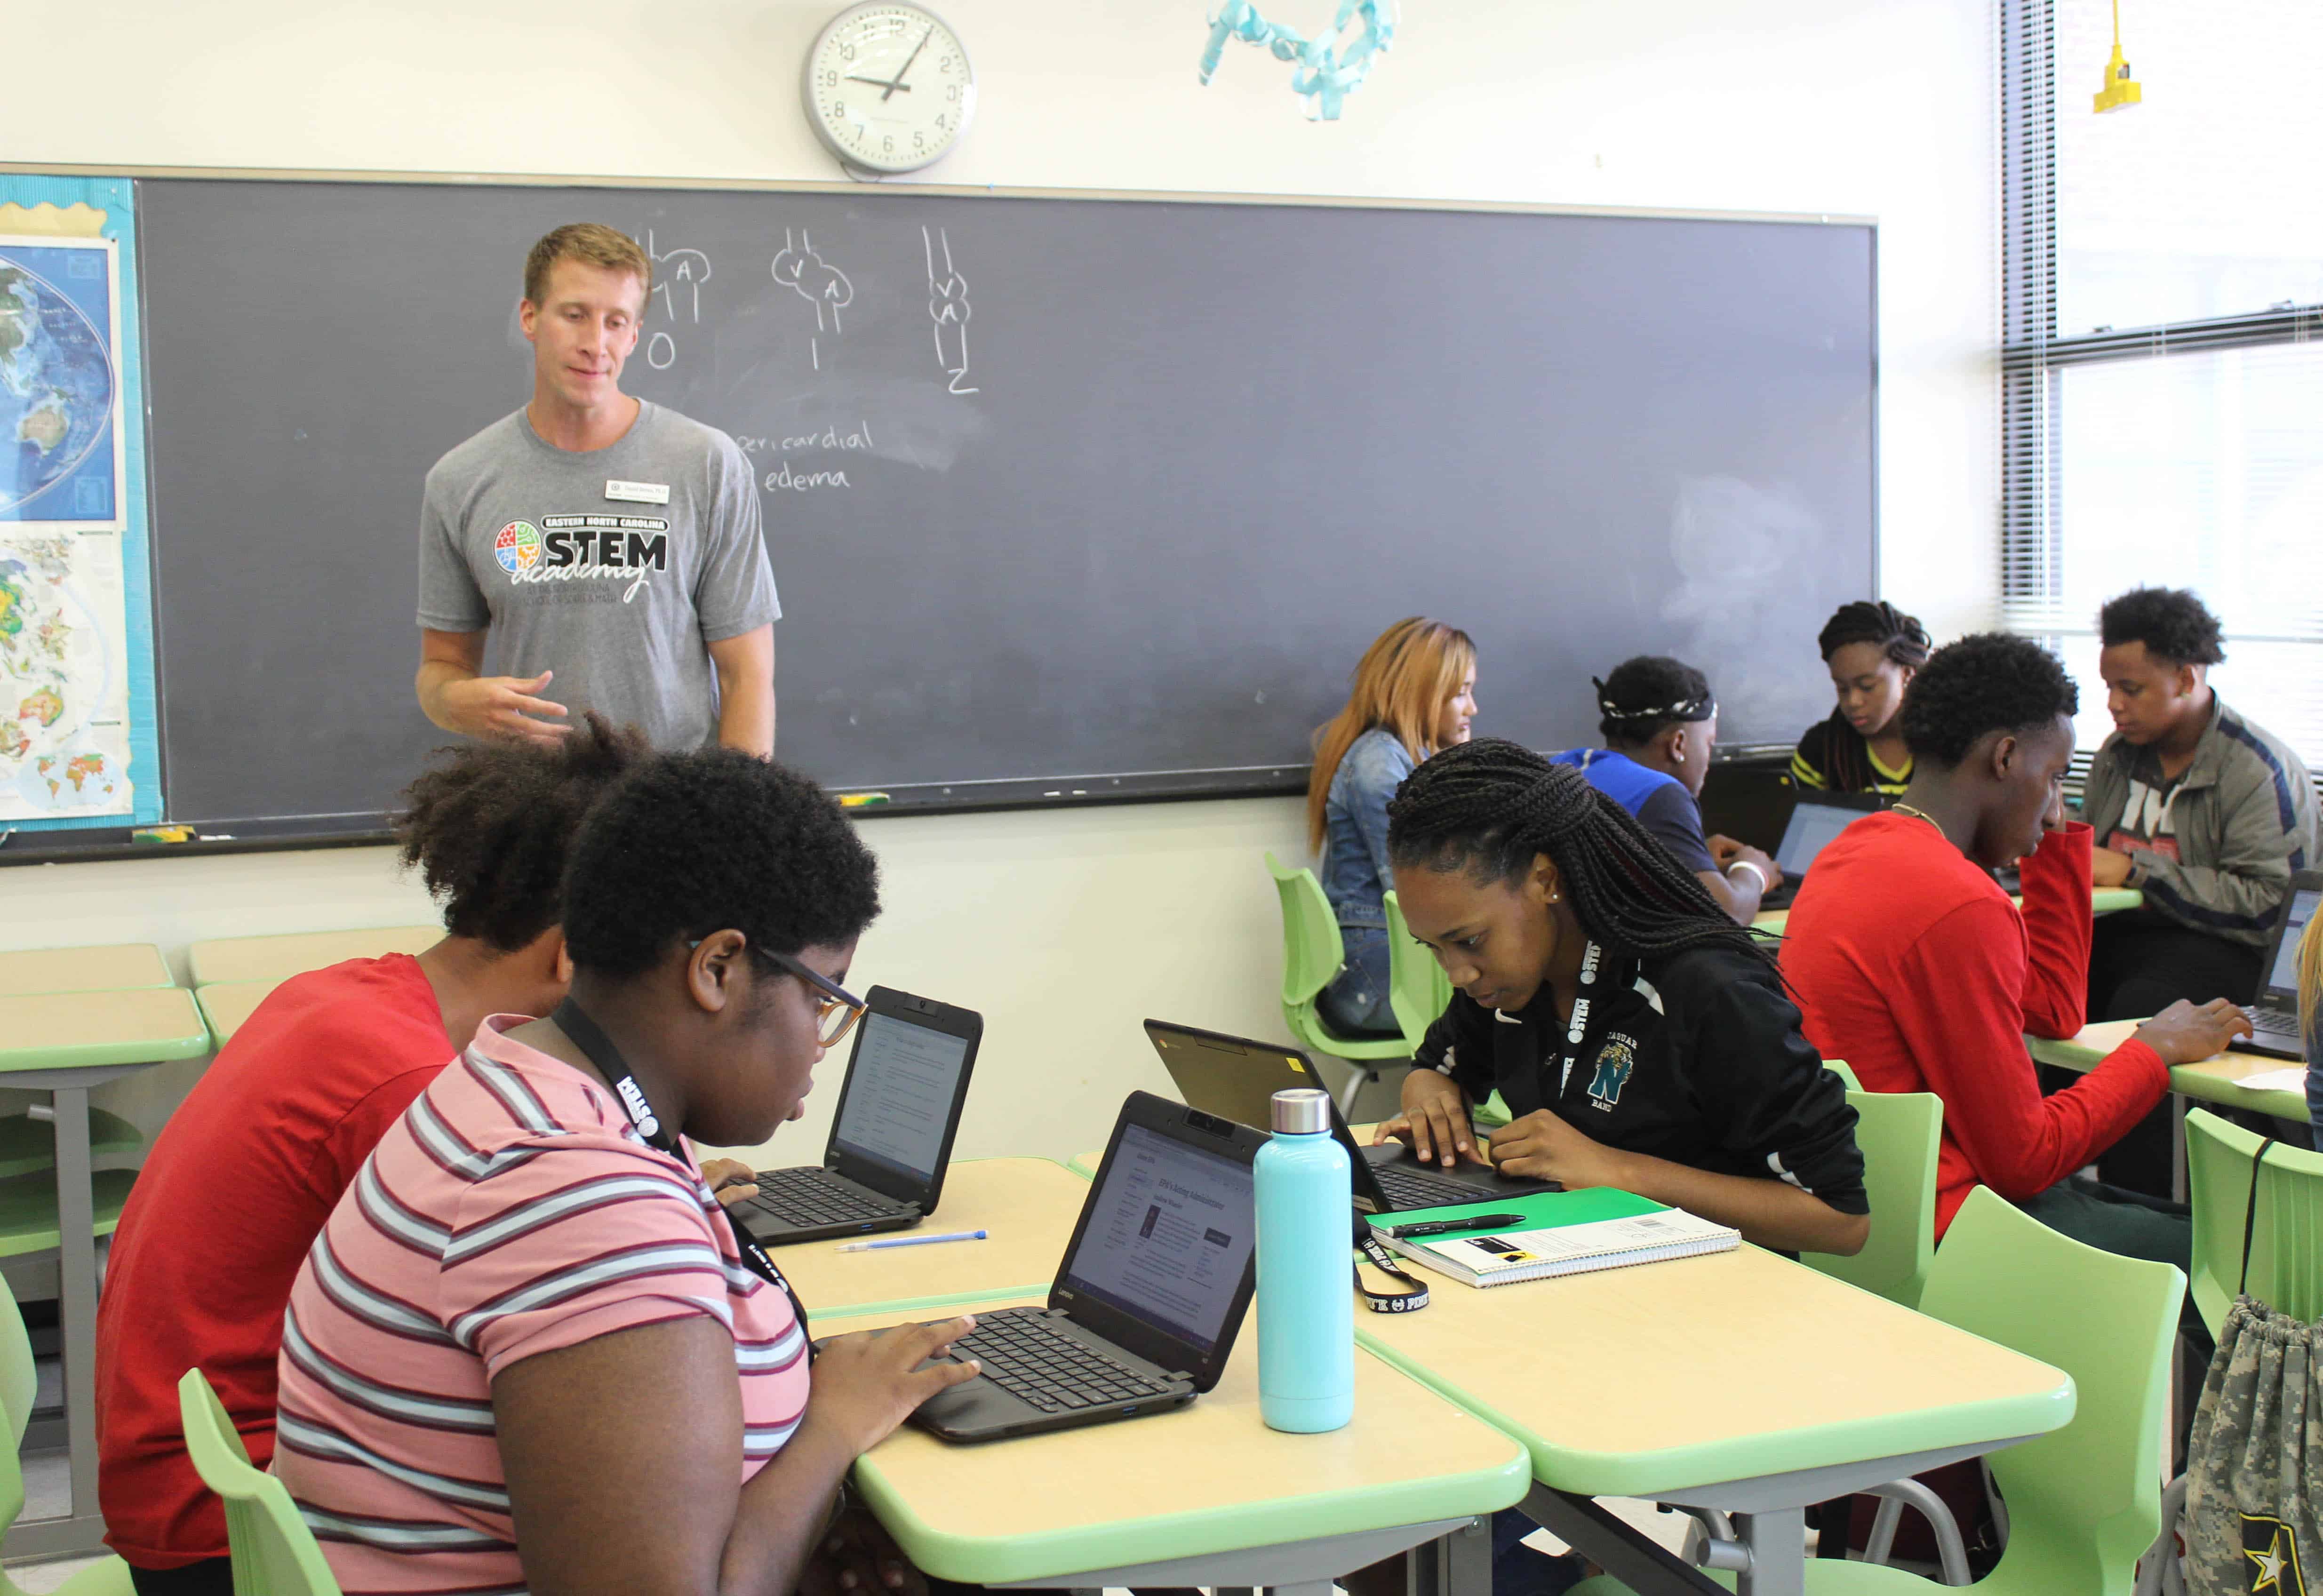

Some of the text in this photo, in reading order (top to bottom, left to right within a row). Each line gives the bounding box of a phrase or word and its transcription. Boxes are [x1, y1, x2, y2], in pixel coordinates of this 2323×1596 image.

[889, 19, 905, 35] 12
[839, 43, 855, 61] 10
[940, 56, 950, 73] 2
[827, 70, 837, 87] 9
[946, 85, 956, 101] 3
[834, 101, 845, 118] 8
[934, 114, 945, 128] 4
[854, 124, 864, 141] 7
[913, 131, 923, 148] 5
[883, 136, 893, 152] 6
[676, 260, 692, 281] A
[790, 259, 804, 279] V
[824, 279, 839, 298] A
[936, 279, 953, 297] V
[941, 303, 958, 325] A
[764, 459, 850, 492] edema
[545, 517, 665, 530] EASTERN NORTH CAROLINA
[545, 531, 667, 571] STEM
[511, 545, 650, 604] academy
[1575, 998, 1590, 1031] STEM
[1607, 1031, 1638, 1050] JAGUAR
[1587, 1058, 1634, 1105] N
[620, 1076, 652, 1120] STEM
[1591, 1099, 1613, 1113] BAND
